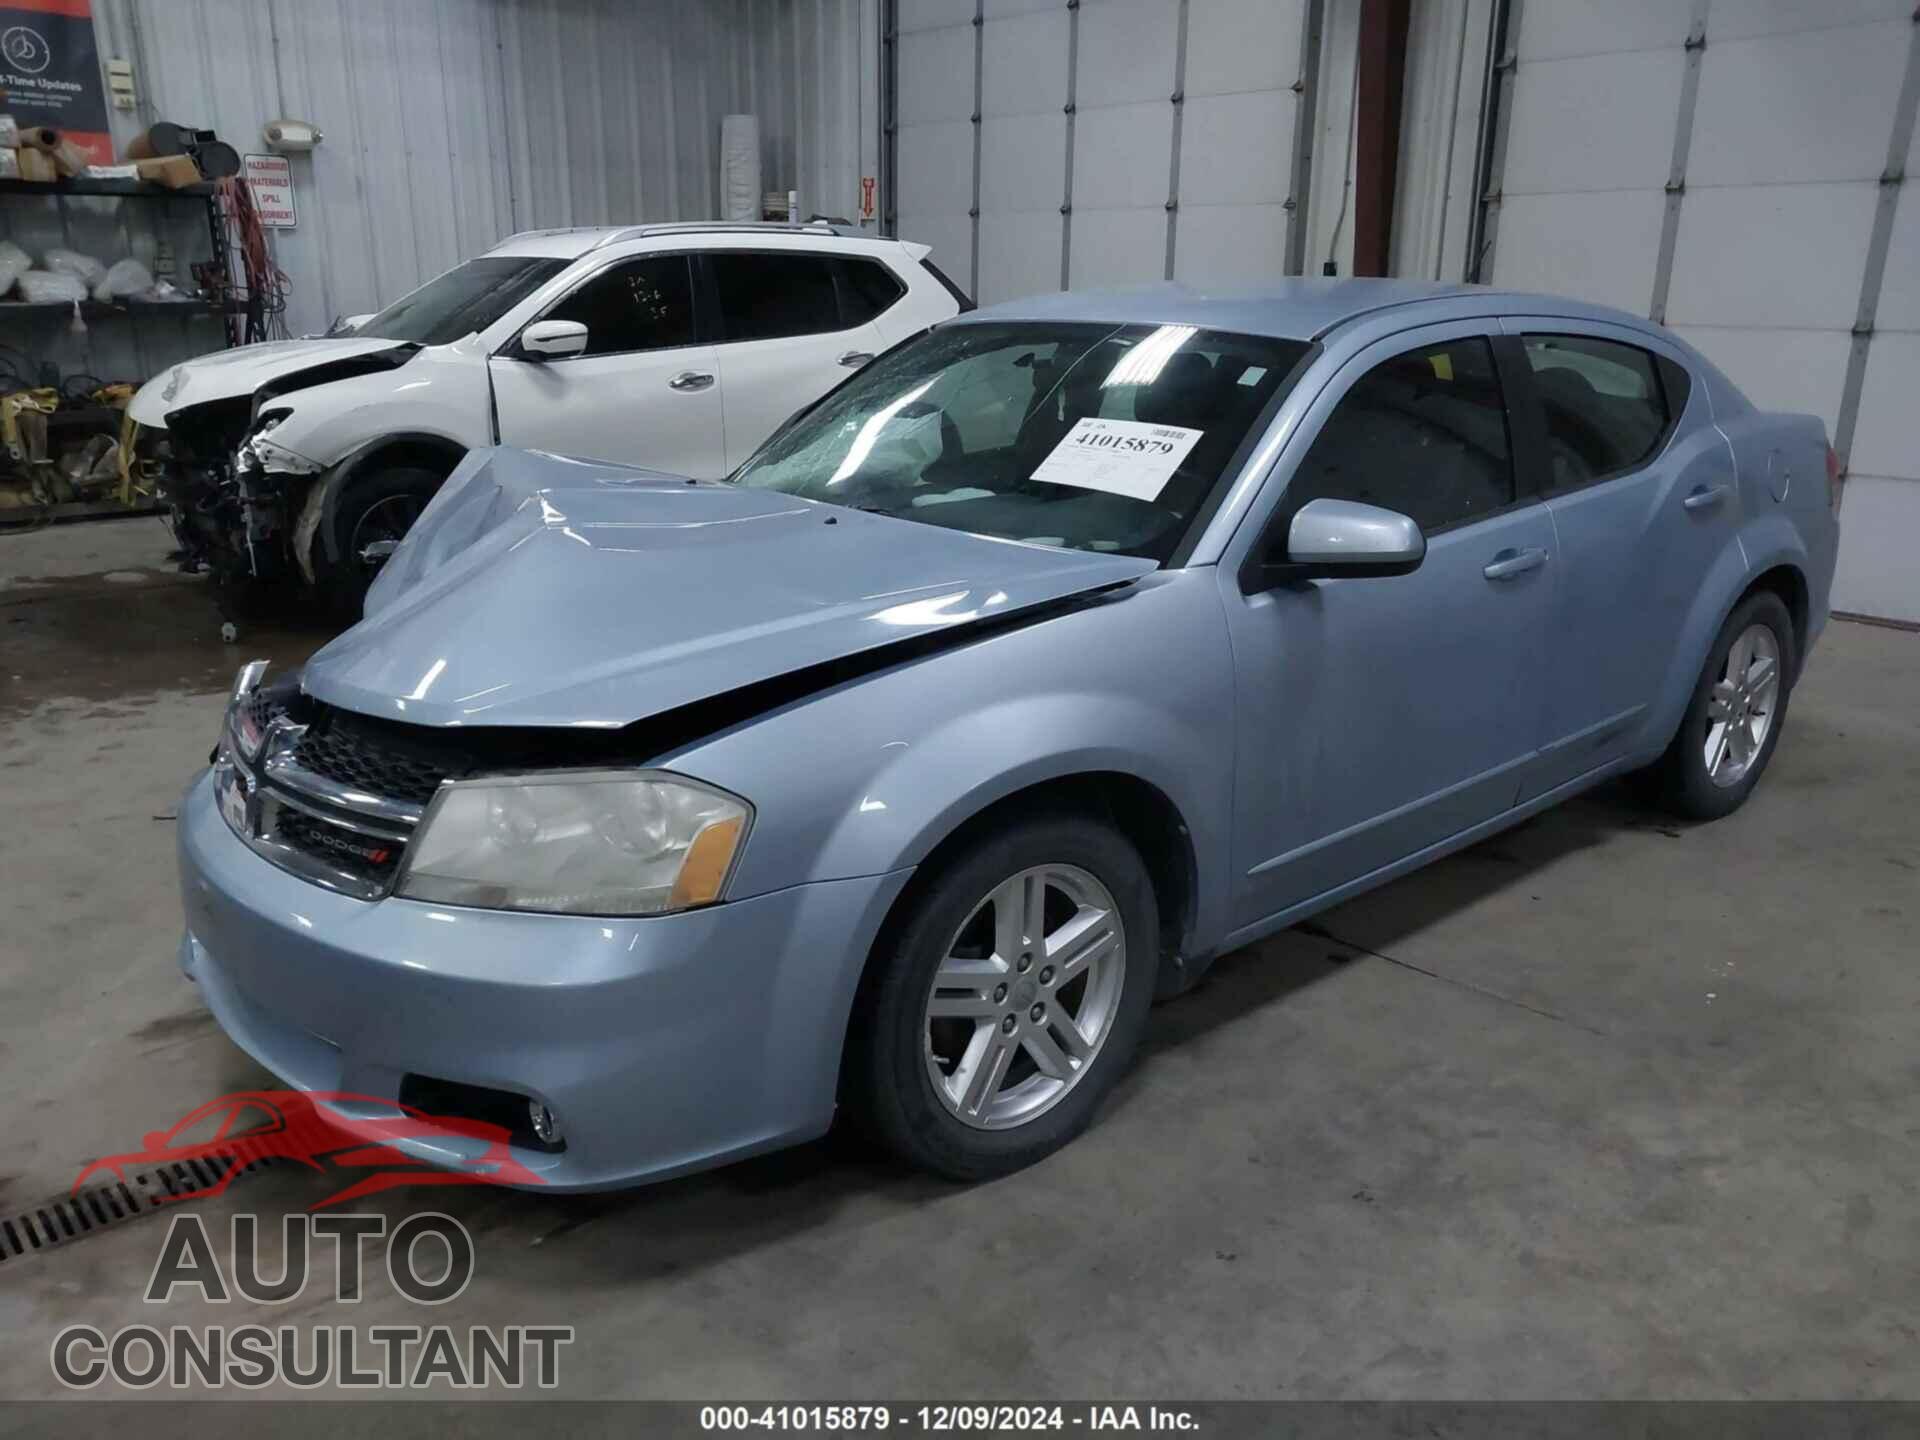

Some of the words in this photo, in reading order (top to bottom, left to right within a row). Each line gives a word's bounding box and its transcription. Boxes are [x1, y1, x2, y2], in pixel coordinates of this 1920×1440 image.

[37, 78, 83, 92] Updates
[247, 161, 288, 171] HAZARDOUS
[262, 194, 281, 203] SPILL
[1075, 432, 1174, 455] 41015879
